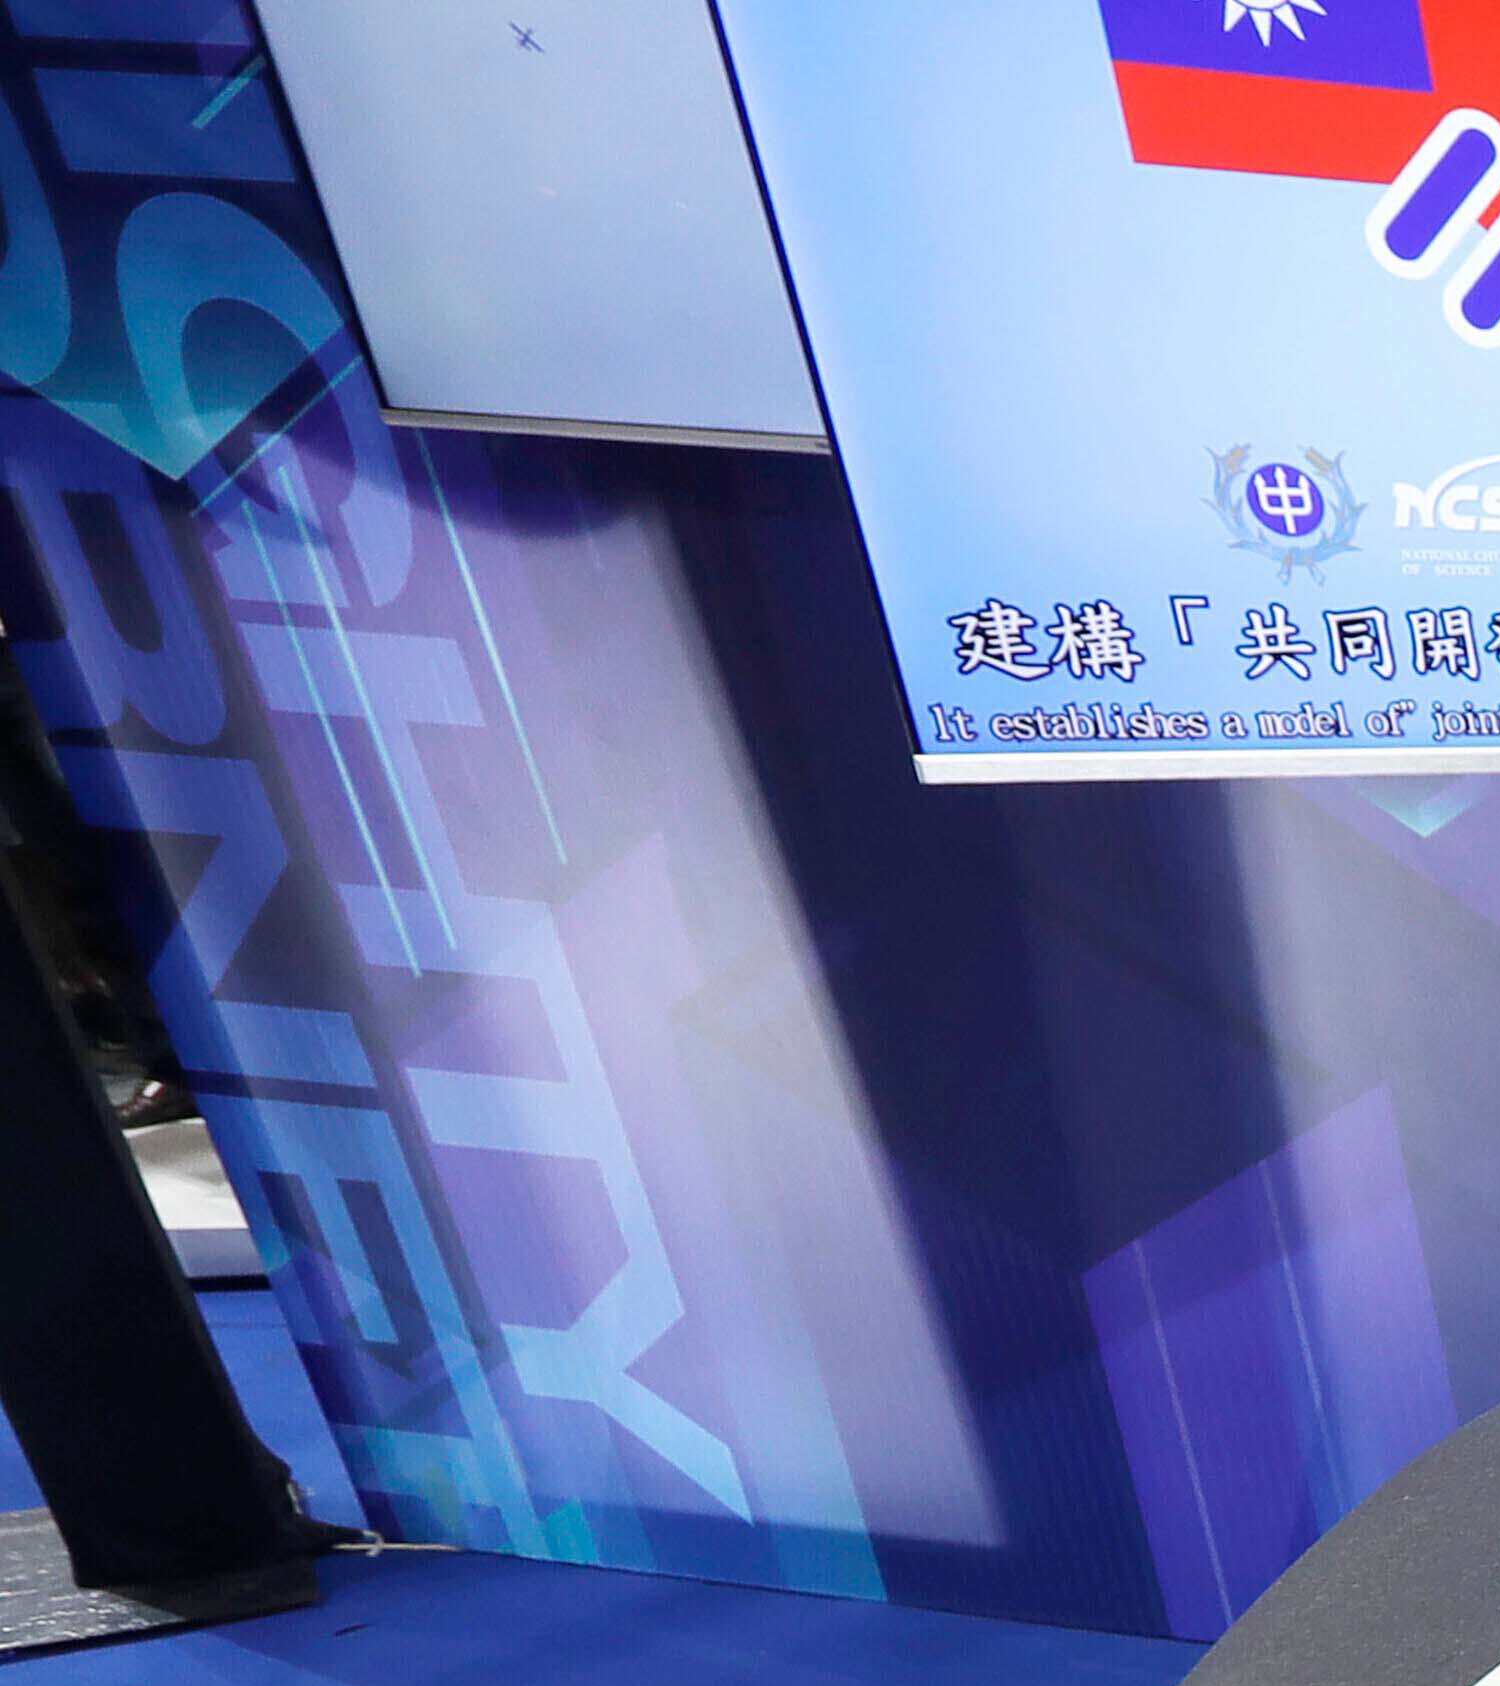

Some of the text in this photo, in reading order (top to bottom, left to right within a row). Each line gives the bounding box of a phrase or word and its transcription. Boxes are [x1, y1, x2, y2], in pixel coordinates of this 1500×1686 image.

[8, 0, 753, 1526] IGHTY
[990, 702, 1209, 741] establishes
[1221, 711, 1248, 739] a
[1256, 701, 1352, 738] model
